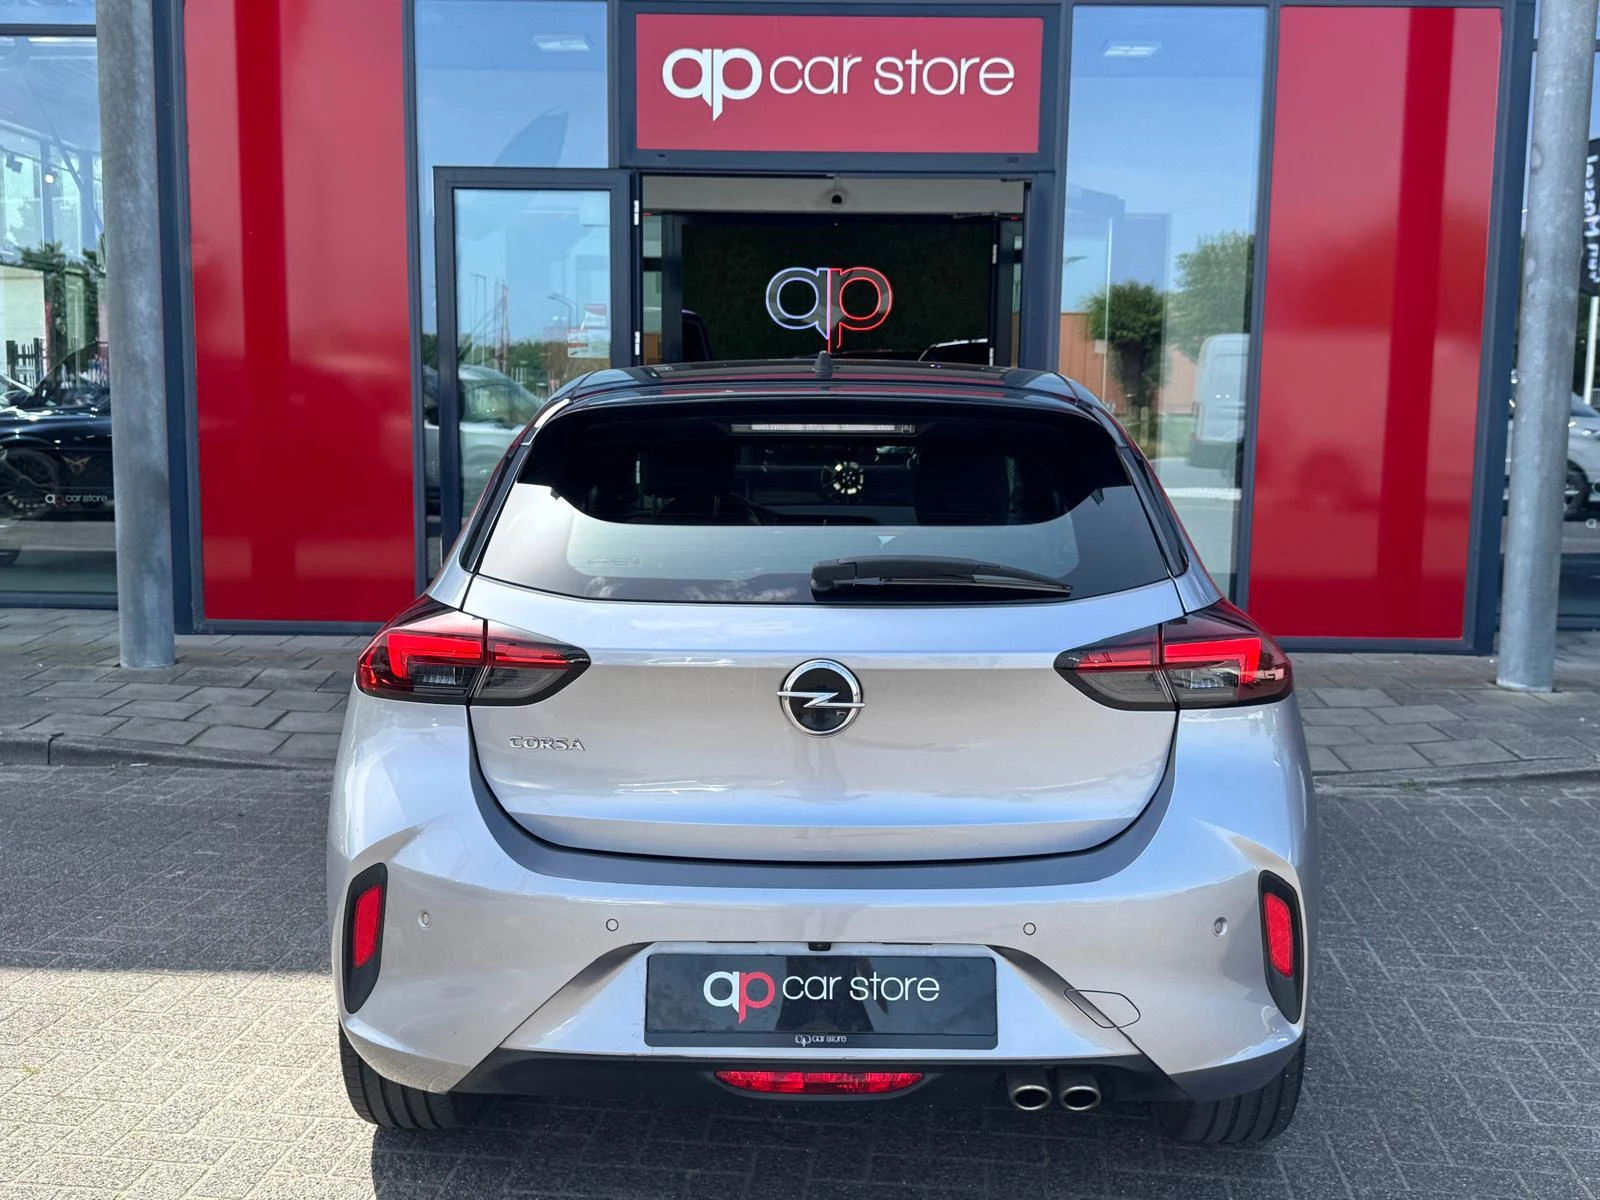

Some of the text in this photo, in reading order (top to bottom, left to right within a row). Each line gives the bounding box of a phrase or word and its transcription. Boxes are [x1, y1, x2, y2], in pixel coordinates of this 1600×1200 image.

[662, 47, 1015, 122] ap car store
[765, 266, 893, 355] ap
[65, 494, 81, 503] car
[82, 494, 108, 503] store
[508, 735, 586, 752] CORSA
[703, 970, 940, 1024] ap car store
[812, 1035, 826, 1043] car
[826, 1035, 847, 1043] store
